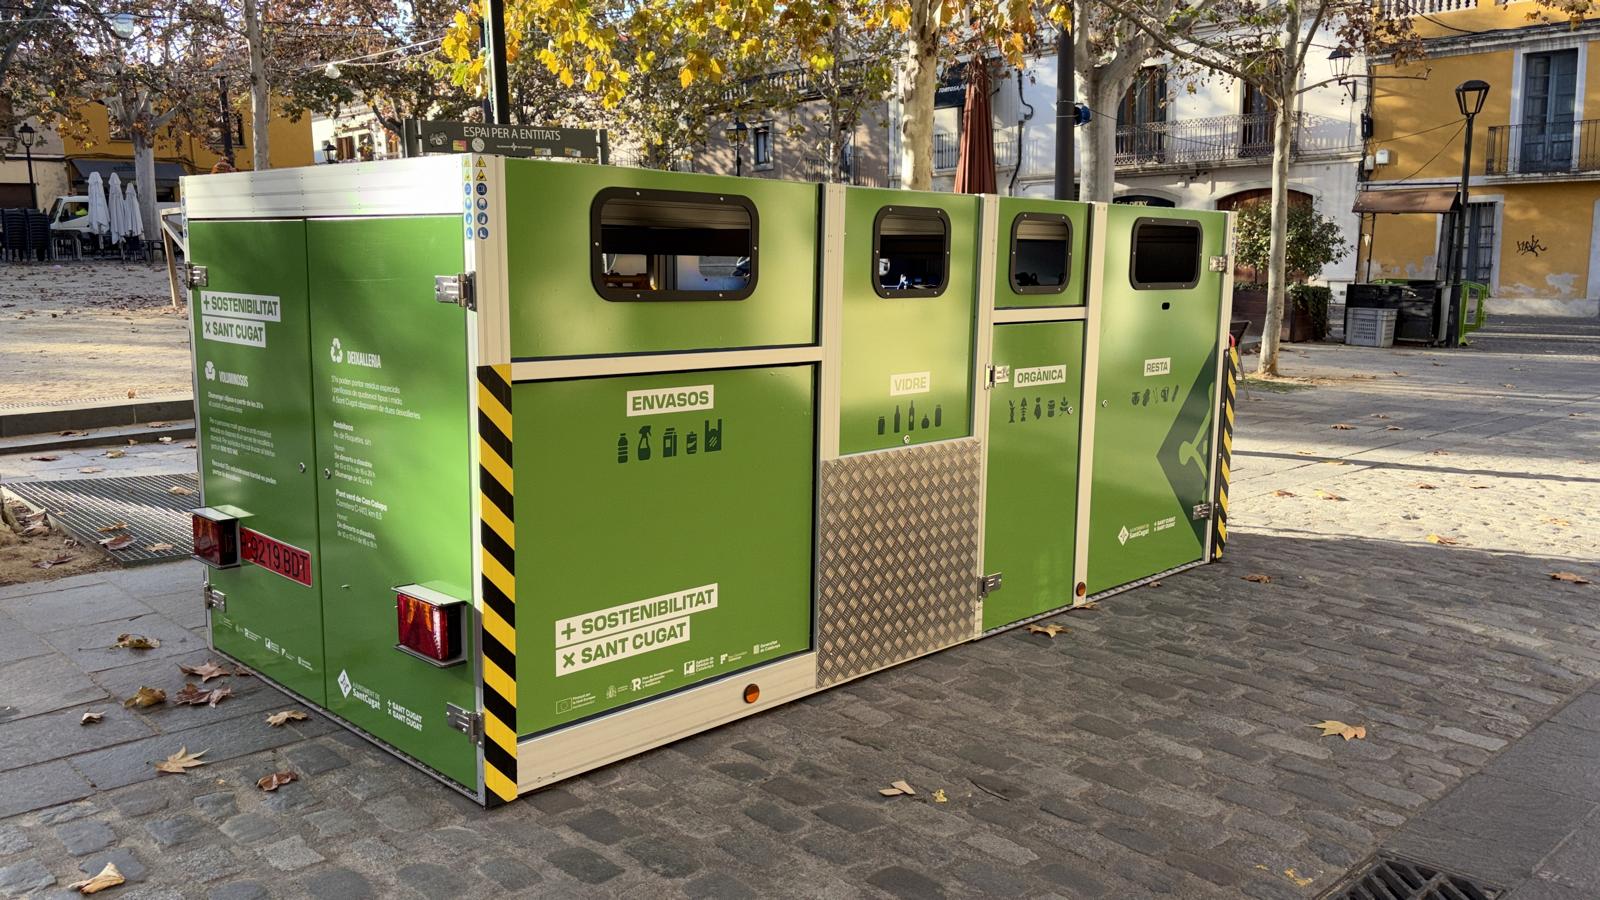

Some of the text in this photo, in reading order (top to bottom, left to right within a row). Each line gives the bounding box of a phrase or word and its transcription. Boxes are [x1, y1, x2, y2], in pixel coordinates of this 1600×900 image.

[463, 126, 561, 141] ESPAI PER A ENTITATS
[211, 296, 278, 316] SOSTENIBILITAT
[213, 322, 234, 338] SANT
[235, 324, 264, 342] CUGAT
[347, 350, 381, 369] DEIXALLERIA
[1146, 361, 1168, 372] RESTA
[894, 376, 927, 391] VIDRE
[1017, 368, 1063, 383] ORGÀNICA
[632, 391, 709, 411] ENVASOS
[251, 536, 280, 569] 9219
[283, 548, 308, 579] BDT
[581, 589, 714, 635] SOSTENIBILITAT
[581, 637, 629, 664] SANT
[632, 622, 686, 650] CUGAT
[392, 702, 405, 713] SANT
[405, 708, 423, 722] CUGAT
